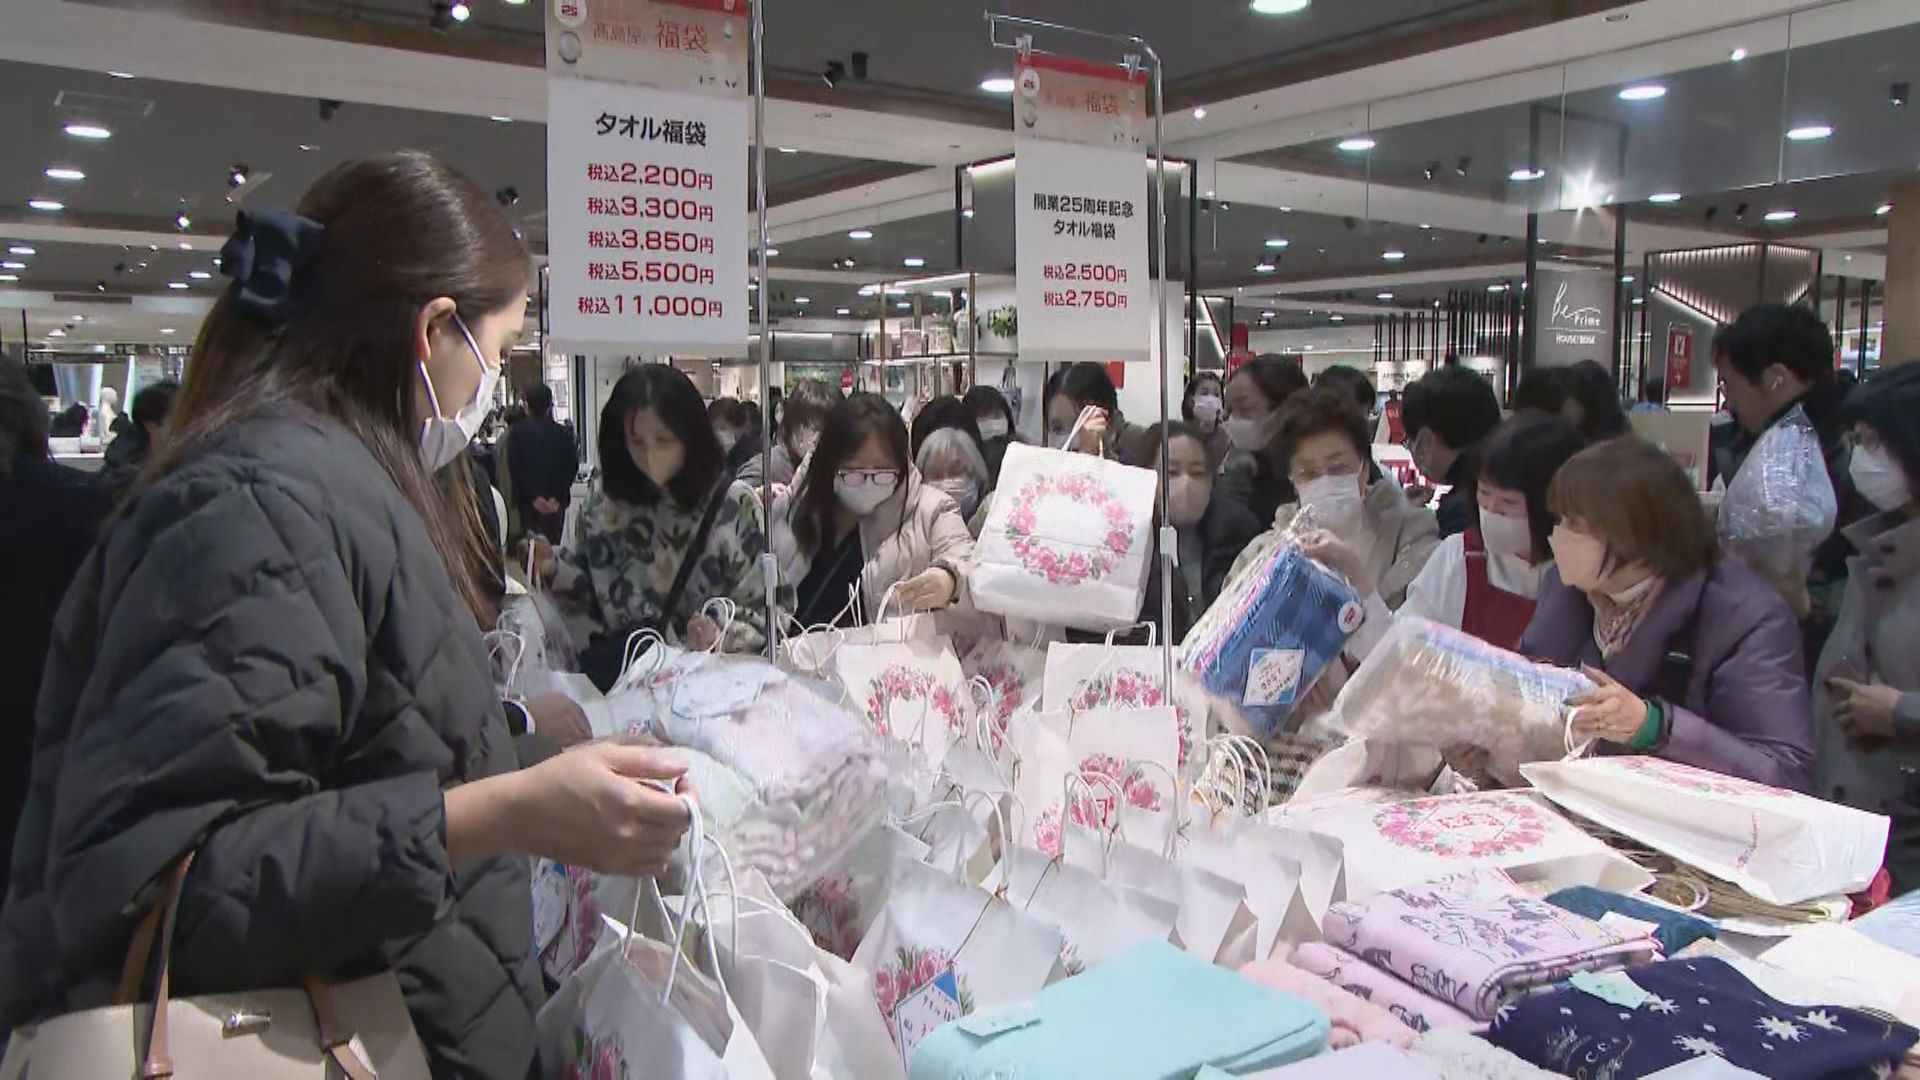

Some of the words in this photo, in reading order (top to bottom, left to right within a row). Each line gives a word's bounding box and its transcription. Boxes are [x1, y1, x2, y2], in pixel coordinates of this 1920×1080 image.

[656, 18, 708, 53] 福袋
[595, 111, 707, 147] タオル福袋
[587, 162, 713, 190] 税込2,200円
[587, 196, 714, 222] 税込3,300円
[1033, 193, 1134, 218] 開業25周年記念
[588, 228, 714, 254] 税込3,850円
[1053, 219, 1116, 240] タオル福袋
[588, 261, 714, 285] 税込5,500円
[1043, 263, 1127, 283] 税込2,500円
[577, 294, 723, 318] 税込11,000円
[1043, 289, 1128, 308] 税込2,750円
